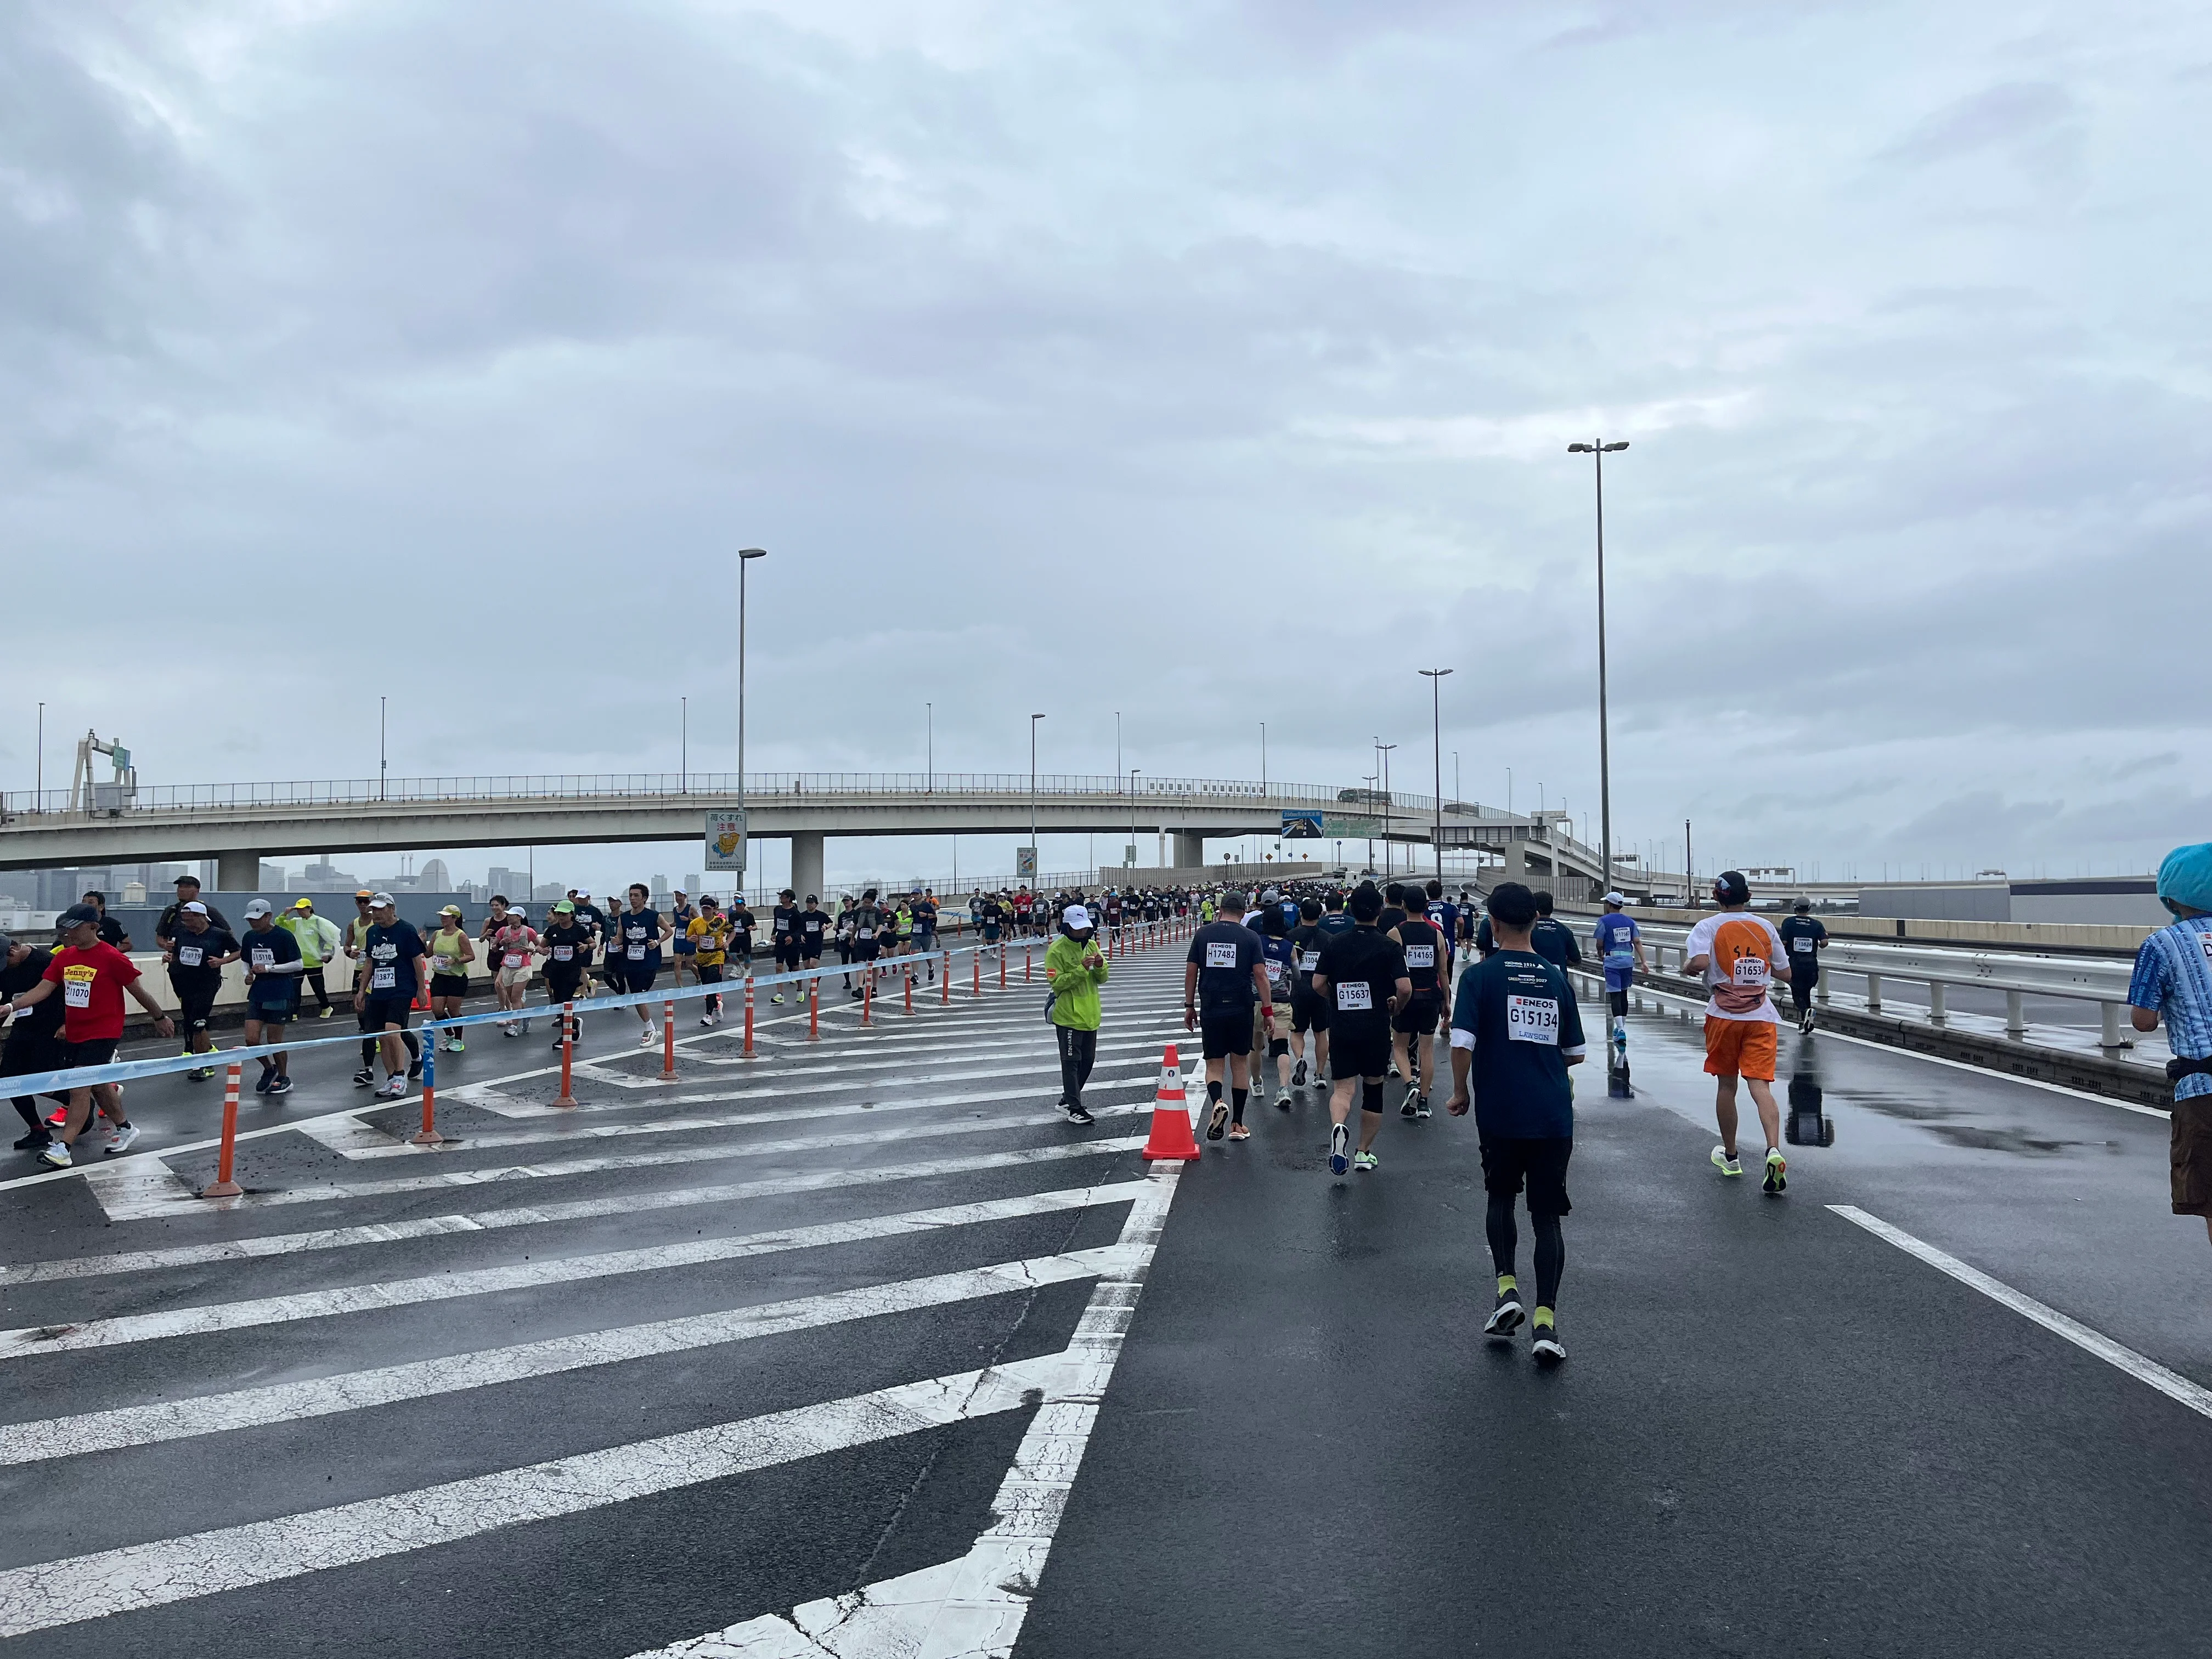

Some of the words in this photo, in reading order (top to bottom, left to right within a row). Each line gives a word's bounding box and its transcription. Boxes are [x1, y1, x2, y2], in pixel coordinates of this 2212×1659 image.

[1208, 950, 1235, 958] H17482
[66, 987, 89, 998] D11070
[1339, 990, 1369, 999] G15637
[1523, 999, 1553, 1008] ENEOS
[1511, 1009, 1557, 1028] G15134
[1519, 1031, 1549, 1041] LAWSON
